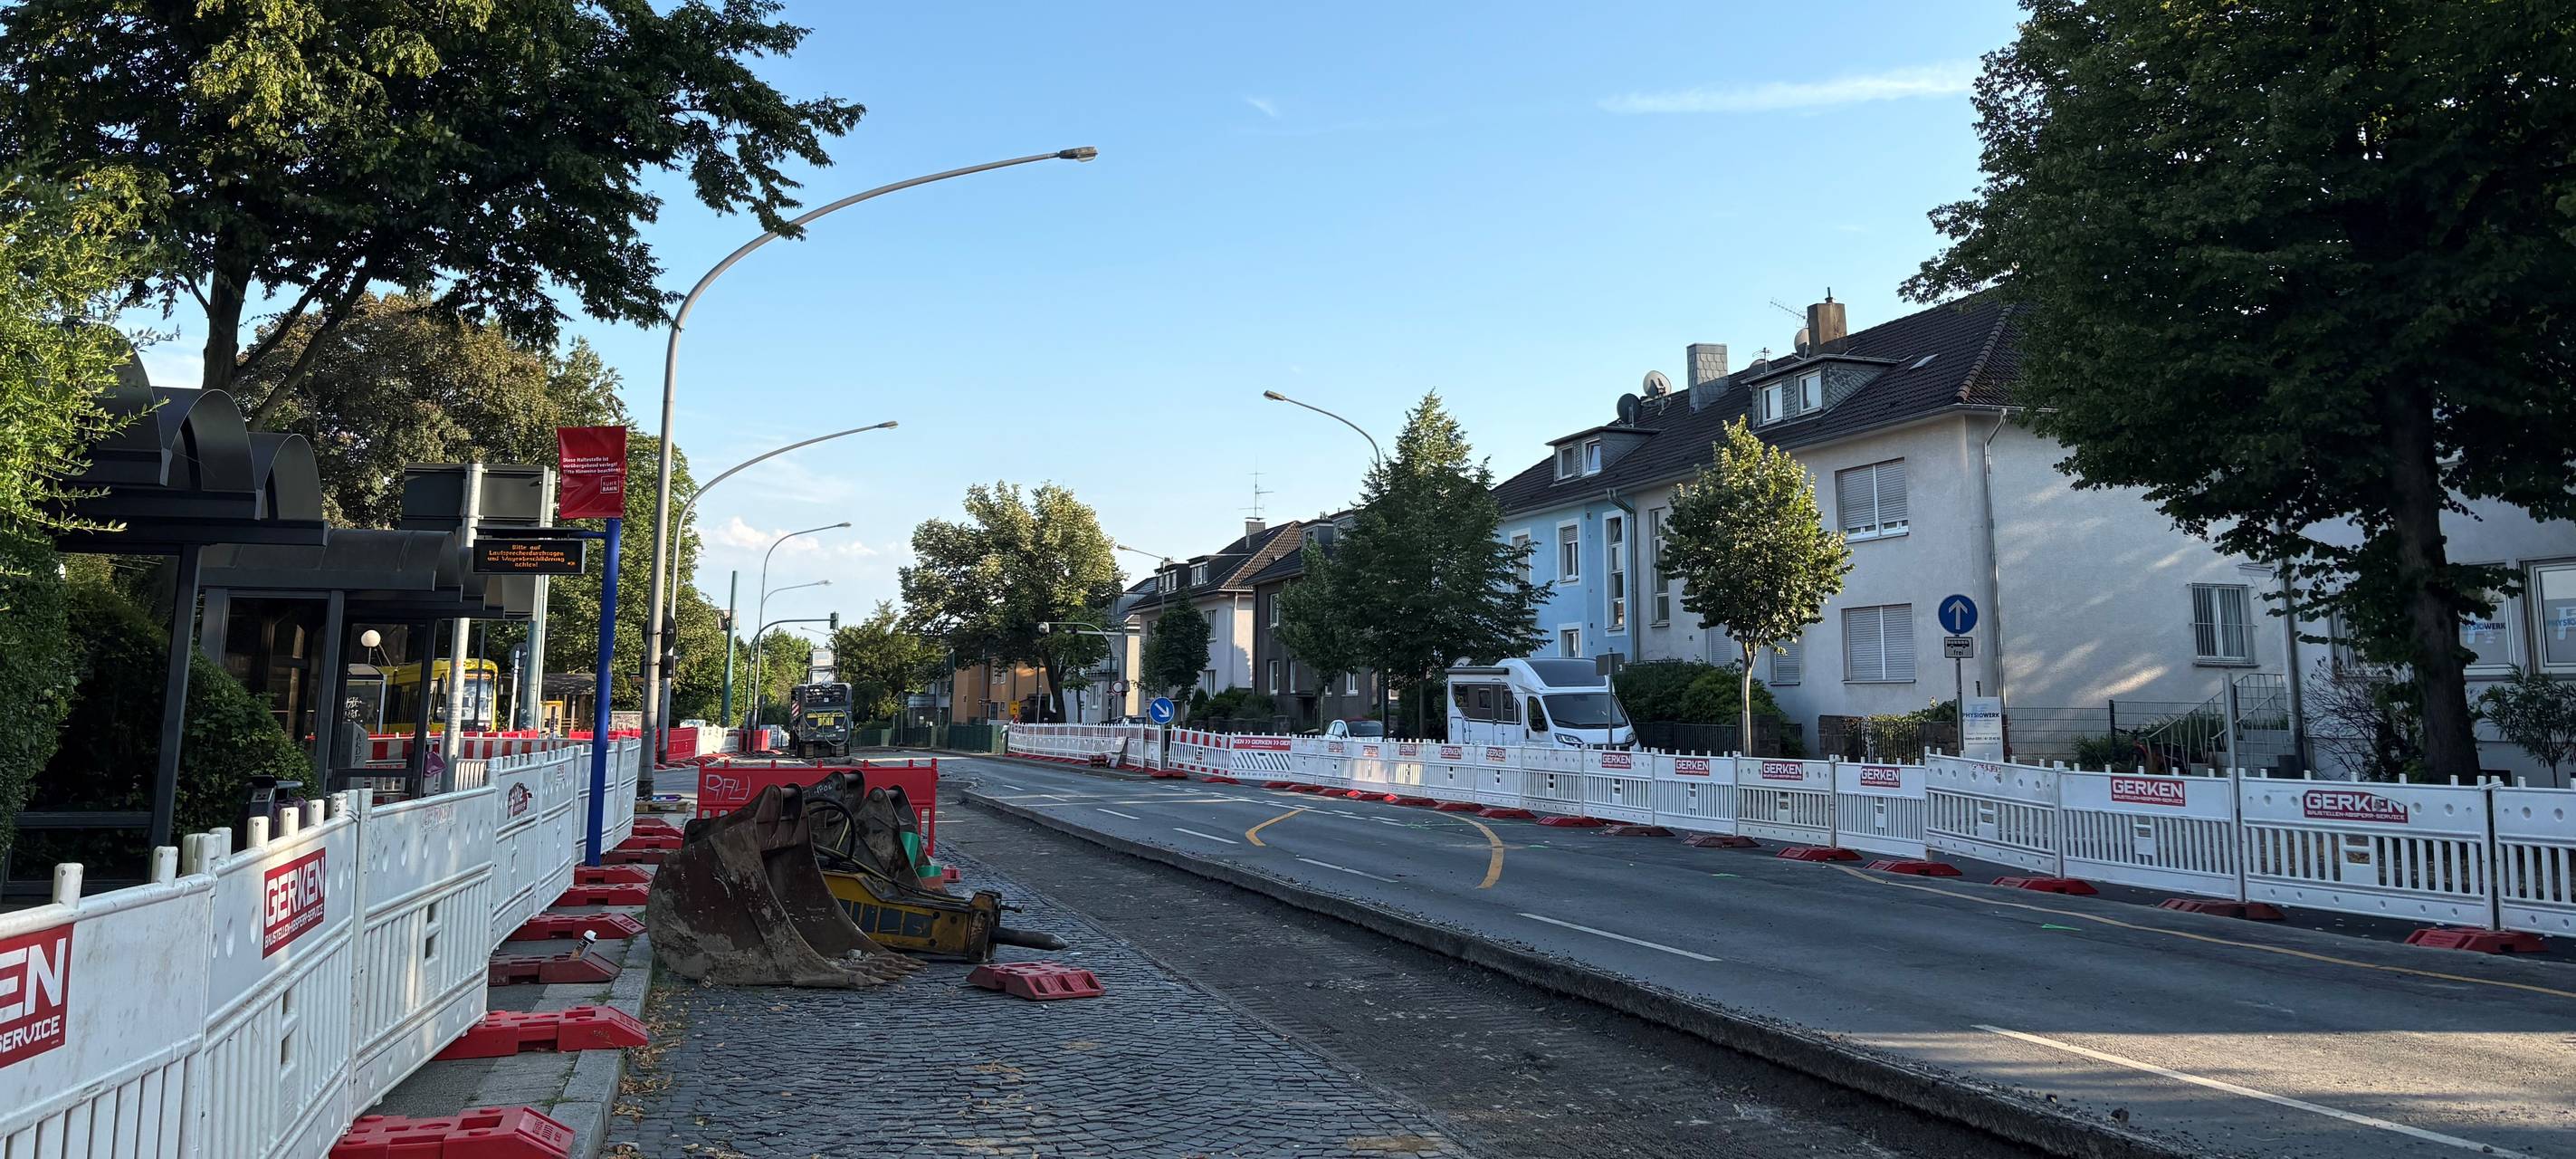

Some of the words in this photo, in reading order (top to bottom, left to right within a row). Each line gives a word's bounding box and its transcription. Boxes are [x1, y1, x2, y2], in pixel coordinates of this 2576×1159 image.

[1602, 754, 1631, 764] GERKEN
[1676, 760, 1709, 771] GERKEN
[1763, 762, 1802, 775] GERKEN
[1861, 767, 1899, 781] GERKEN
[2112, 779, 2183, 798] GERKEN
[2305, 793, 2405, 813] GERKEN
[266, 857, 324, 928] GERKEN
